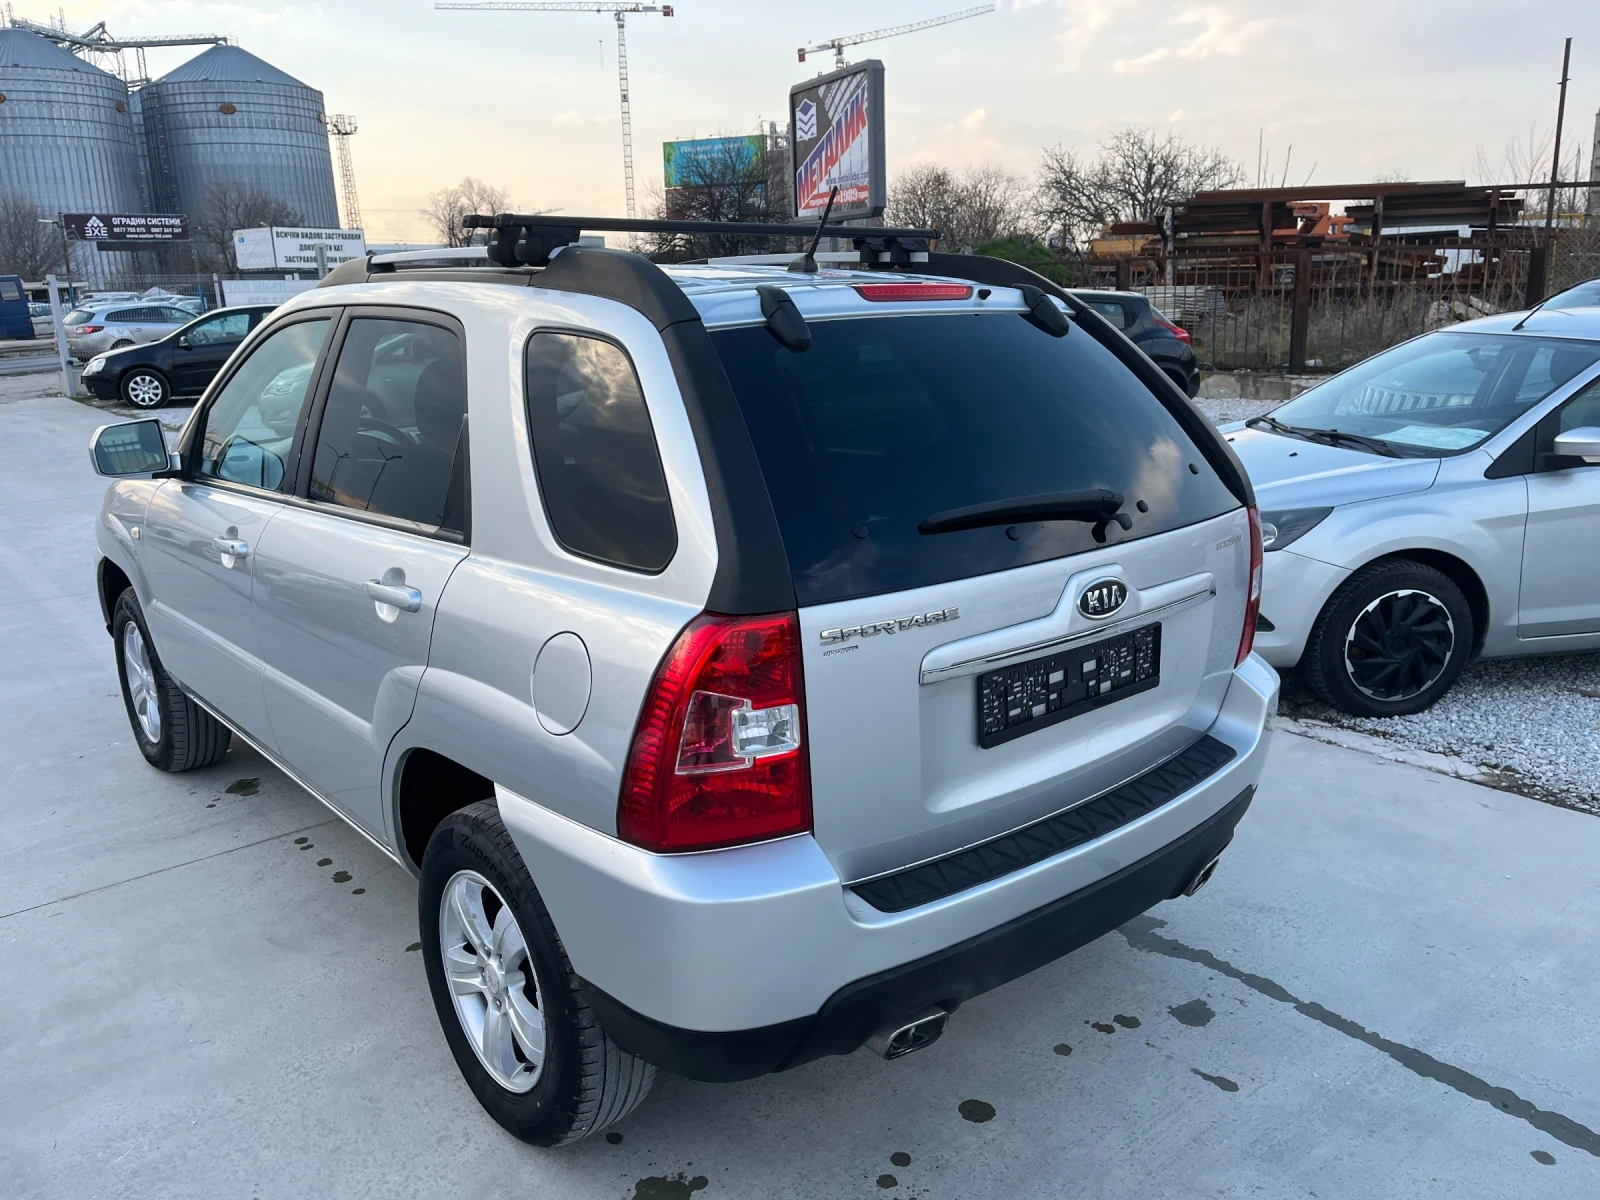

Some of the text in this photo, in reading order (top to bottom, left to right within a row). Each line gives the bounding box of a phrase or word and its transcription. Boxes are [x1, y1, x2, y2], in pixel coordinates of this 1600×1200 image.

[796, 80, 868, 210] МЕТАЛИК
[839, 187, 858, 203] 1989
[112, 217, 180, 225] ОГРАДНИ СИСТЕМИ
[275, 230, 361, 240] ВСИЧКИ ВИДОВЕ ЗАСТРАХОВКИ
[333, 244, 343, 252] КАТ
[1086, 584, 1123, 613] KIA
[819, 606, 961, 646] SPORTAGE
